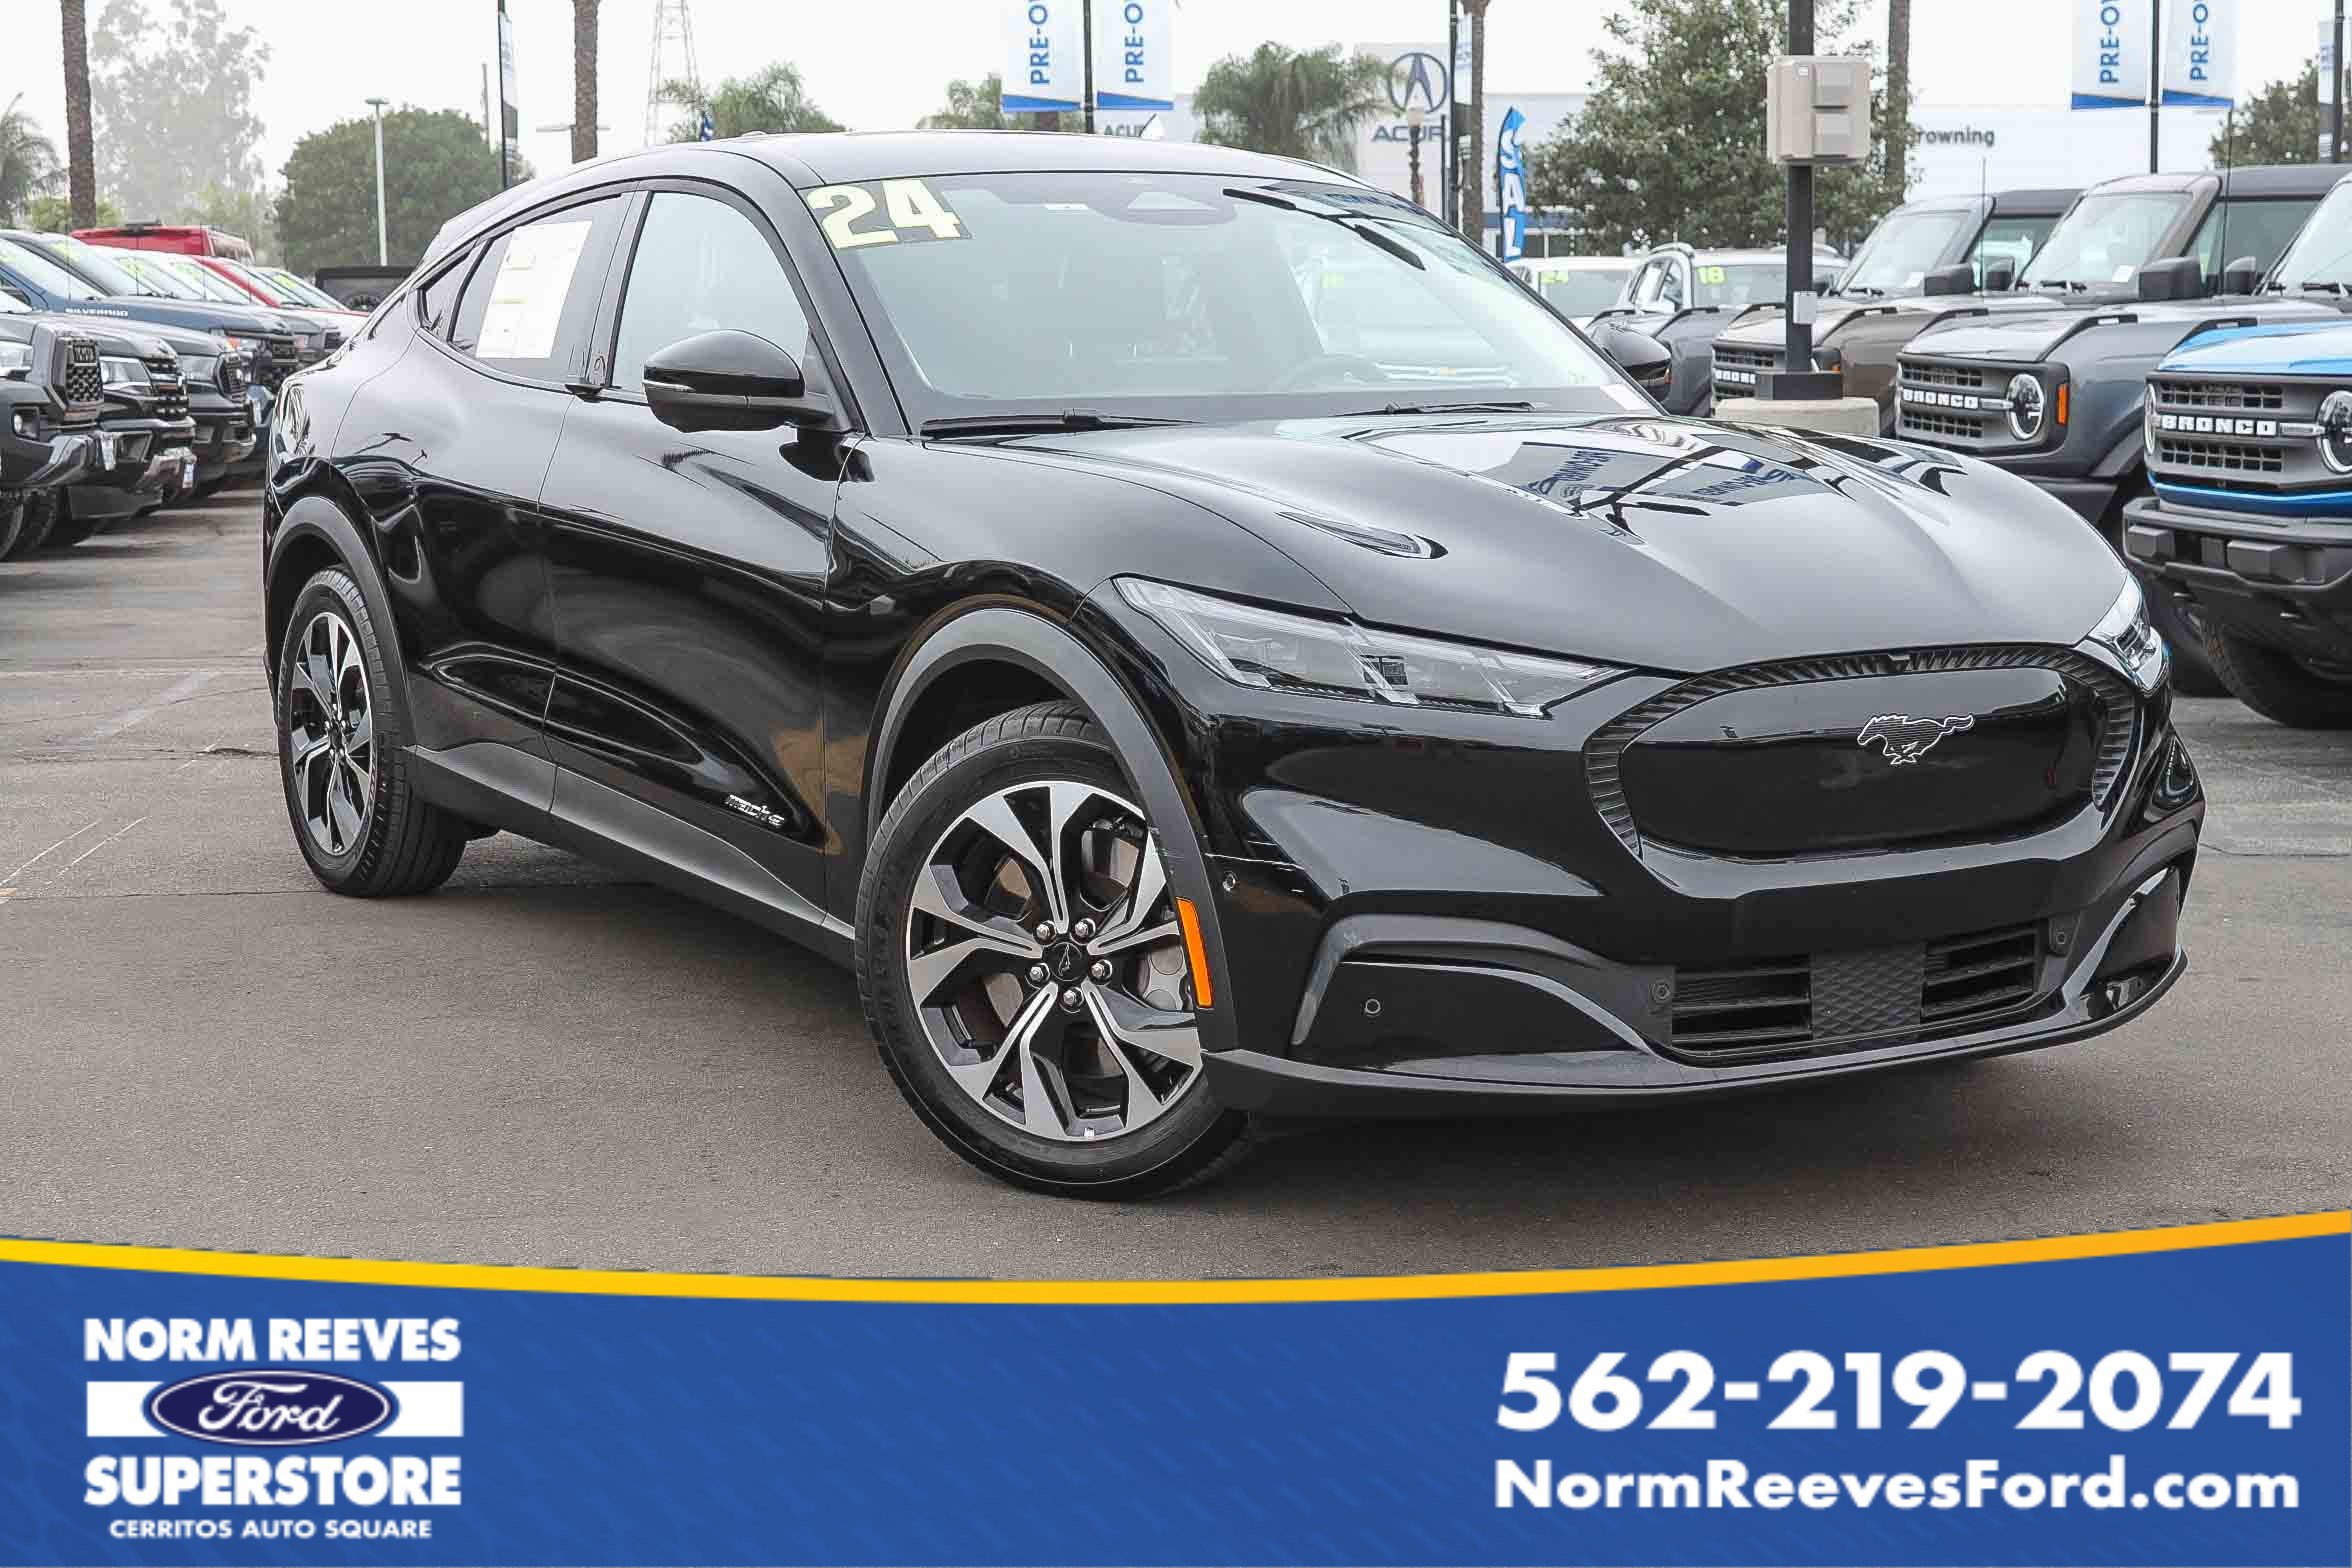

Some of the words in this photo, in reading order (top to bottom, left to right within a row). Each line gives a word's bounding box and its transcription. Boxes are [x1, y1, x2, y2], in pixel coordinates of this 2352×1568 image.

[1029, 0, 1050, 85] PRE-O
[1125, 0, 1144, 83] PRE-O
[2100, 0, 2120, 83] PRE-O
[2190, 0, 2208, 81] PRE-O
[1919, 125, 1994, 147] rowning
[806, 179, 961, 249] 24
[1500, 129, 1524, 257] SAL
[1697, 266, 1726, 284] 18
[1902, 389, 1978, 409] BRONCO
[2161, 415, 2276, 436] BRONCO
